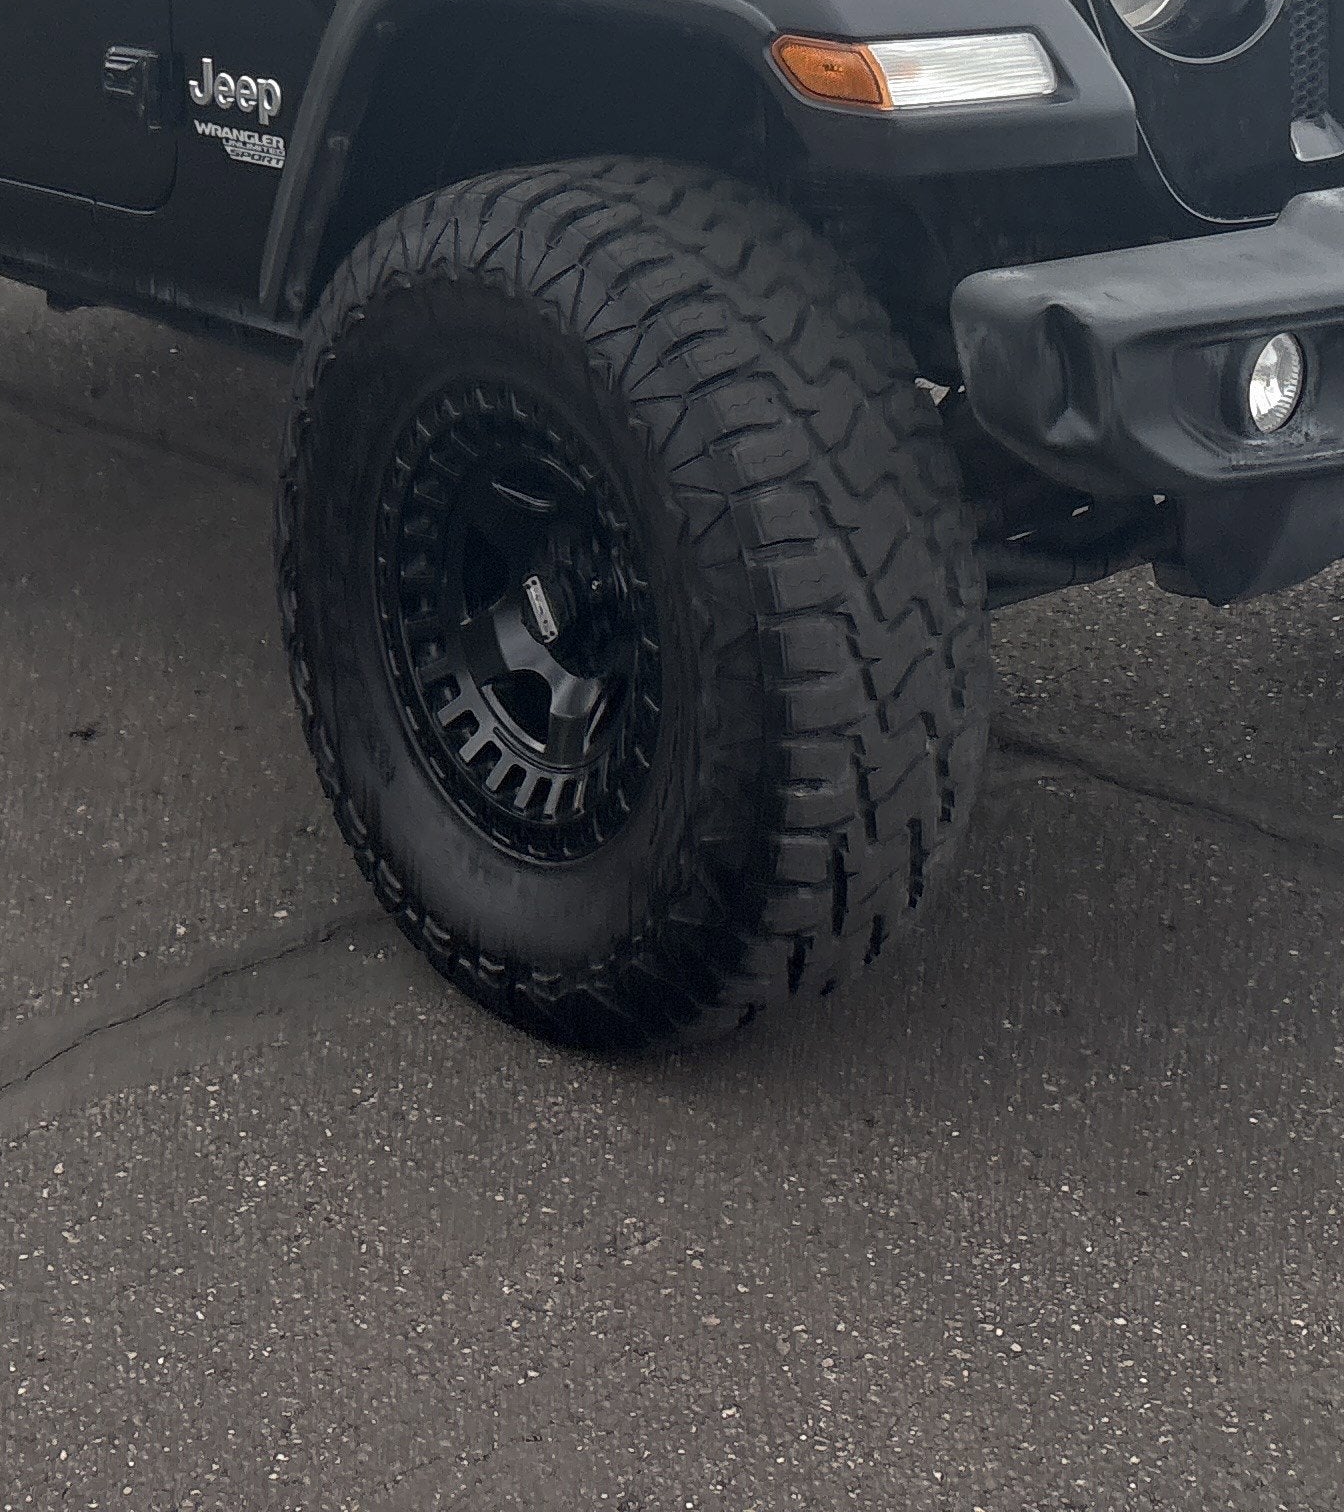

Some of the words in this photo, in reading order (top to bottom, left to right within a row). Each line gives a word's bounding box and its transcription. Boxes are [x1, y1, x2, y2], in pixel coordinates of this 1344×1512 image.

[188, 57, 281, 126] Jeep
[193, 118, 286, 149] WRANGLER
[229, 148, 285, 167] SPORT
